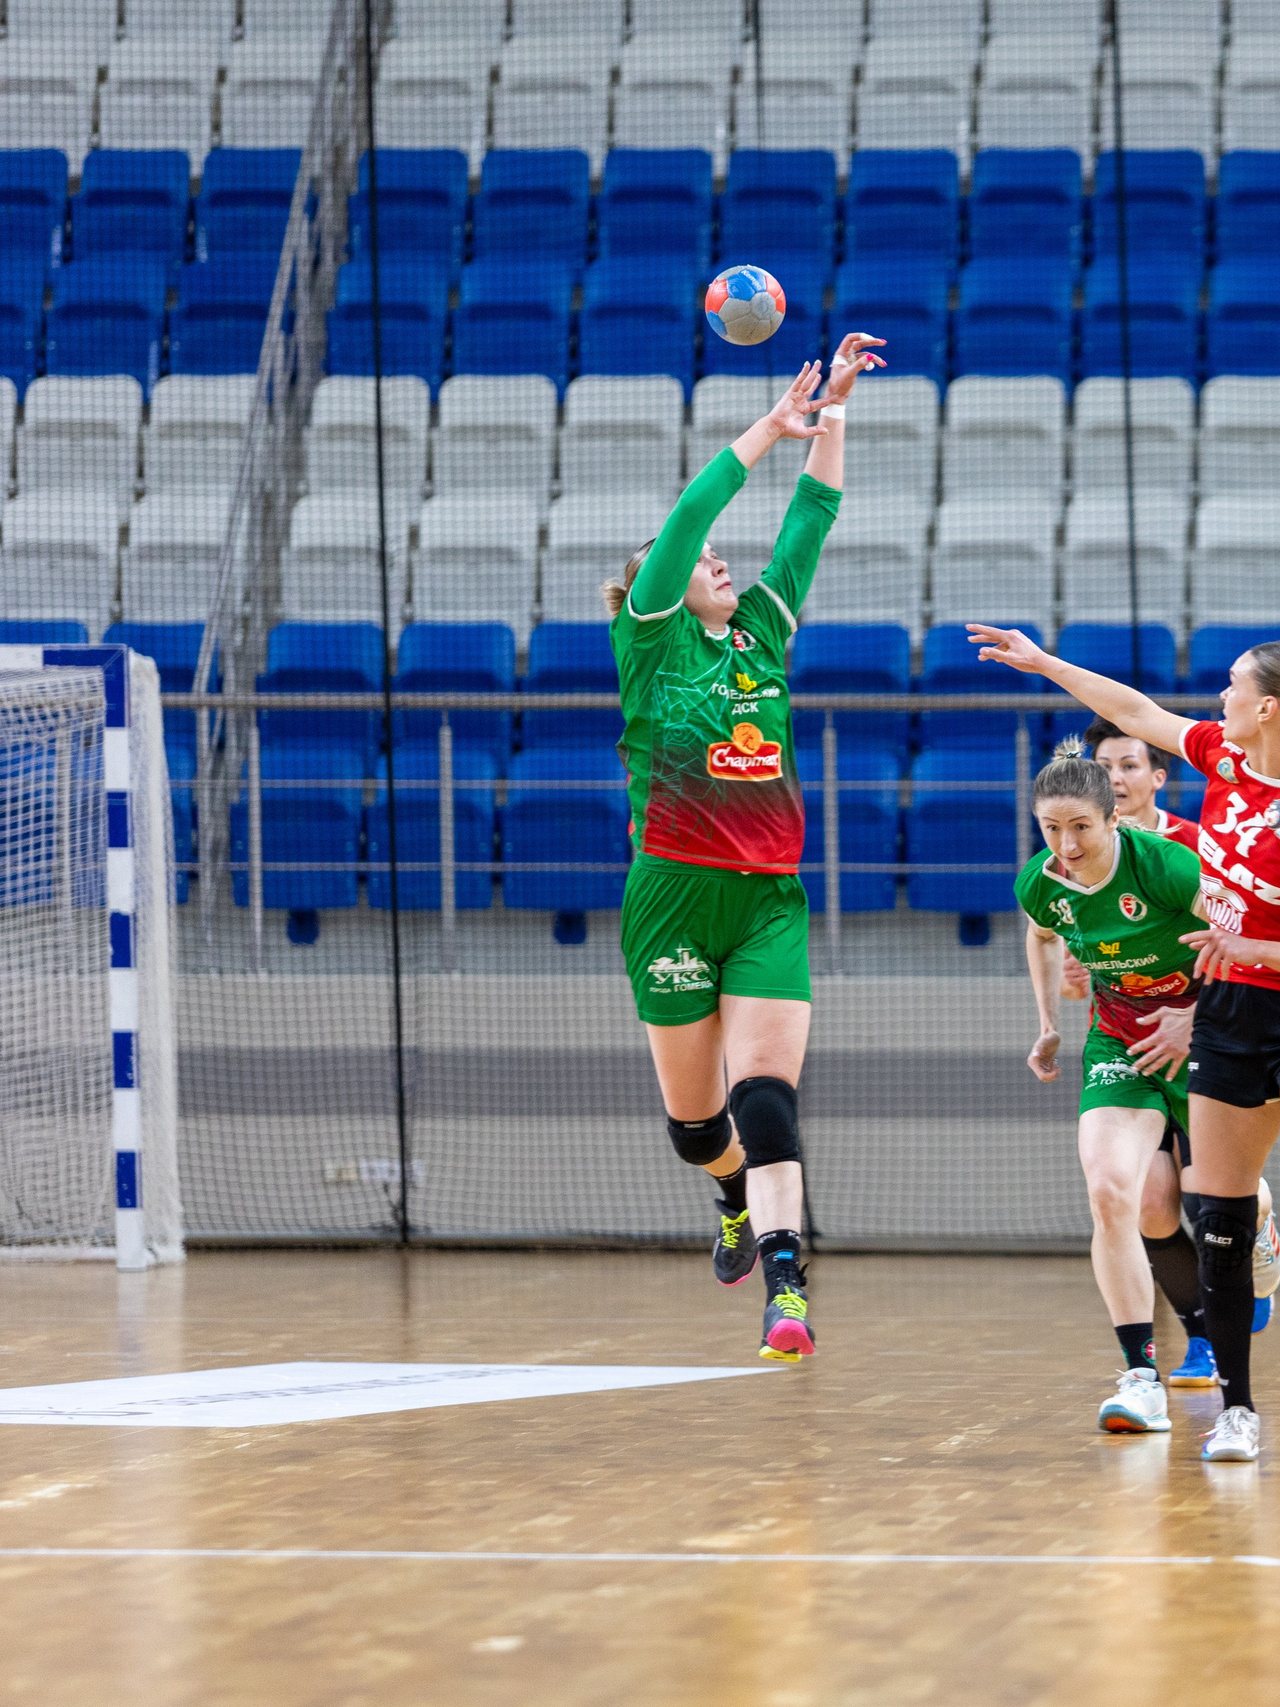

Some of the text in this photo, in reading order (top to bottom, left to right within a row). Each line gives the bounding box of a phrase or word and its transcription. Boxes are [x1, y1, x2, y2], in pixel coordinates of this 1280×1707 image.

[732, 702, 760, 716] ДСК
[1212, 791, 1267, 858] 34
[653, 969, 709, 985] УКС
[1204, 1232, 1233, 1245] SELECT
